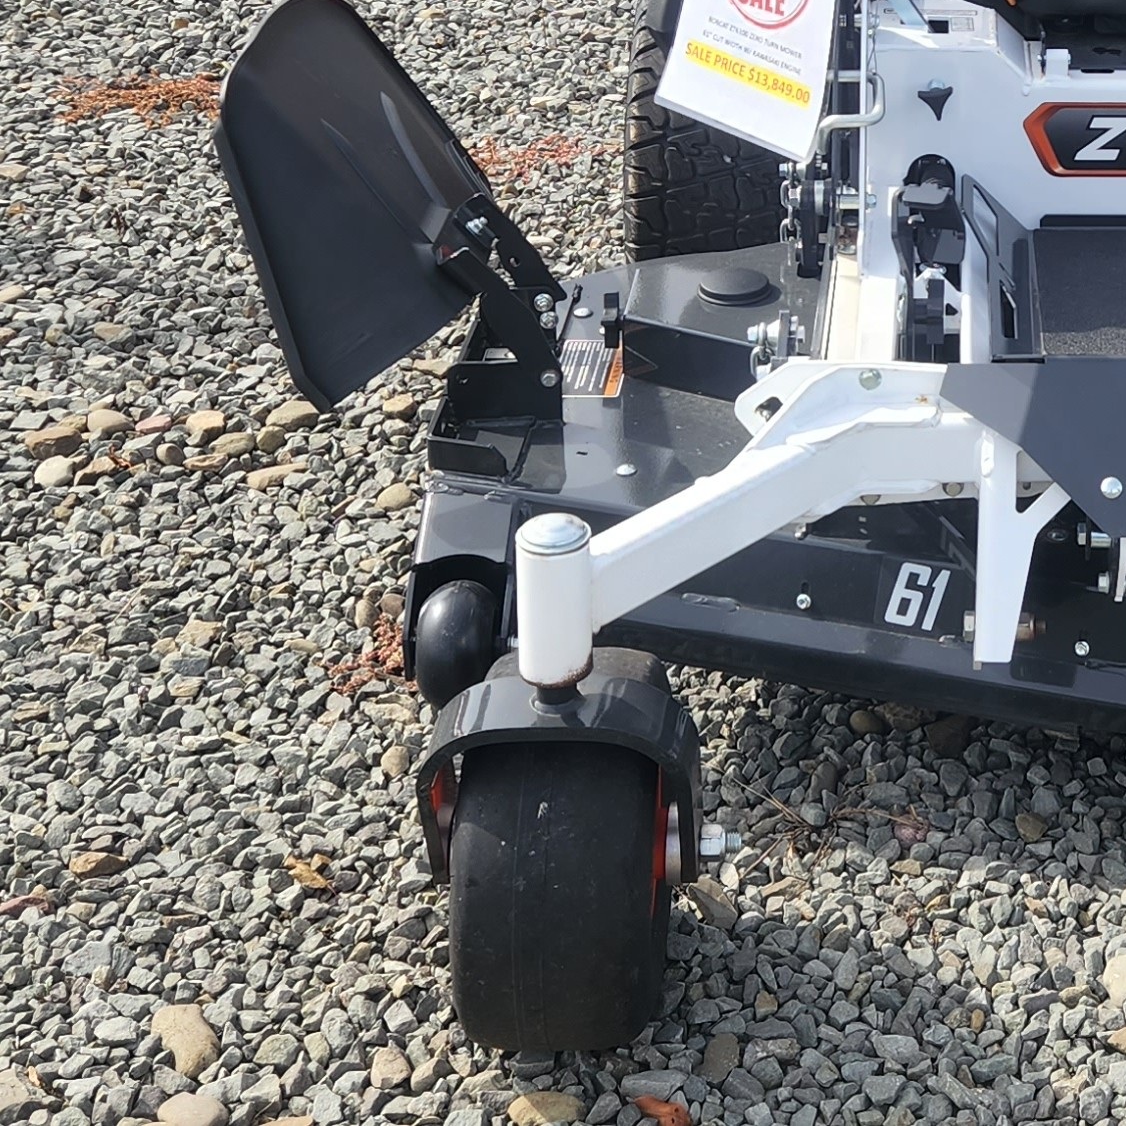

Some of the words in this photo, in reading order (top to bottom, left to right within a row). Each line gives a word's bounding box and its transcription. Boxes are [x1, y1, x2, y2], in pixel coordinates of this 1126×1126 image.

[685, 42, 712, 64] SALE
[714, 54, 746, 78] PRICE
[747, 67, 811, 104] $13,849.00
[884, 562, 951, 632] 61
